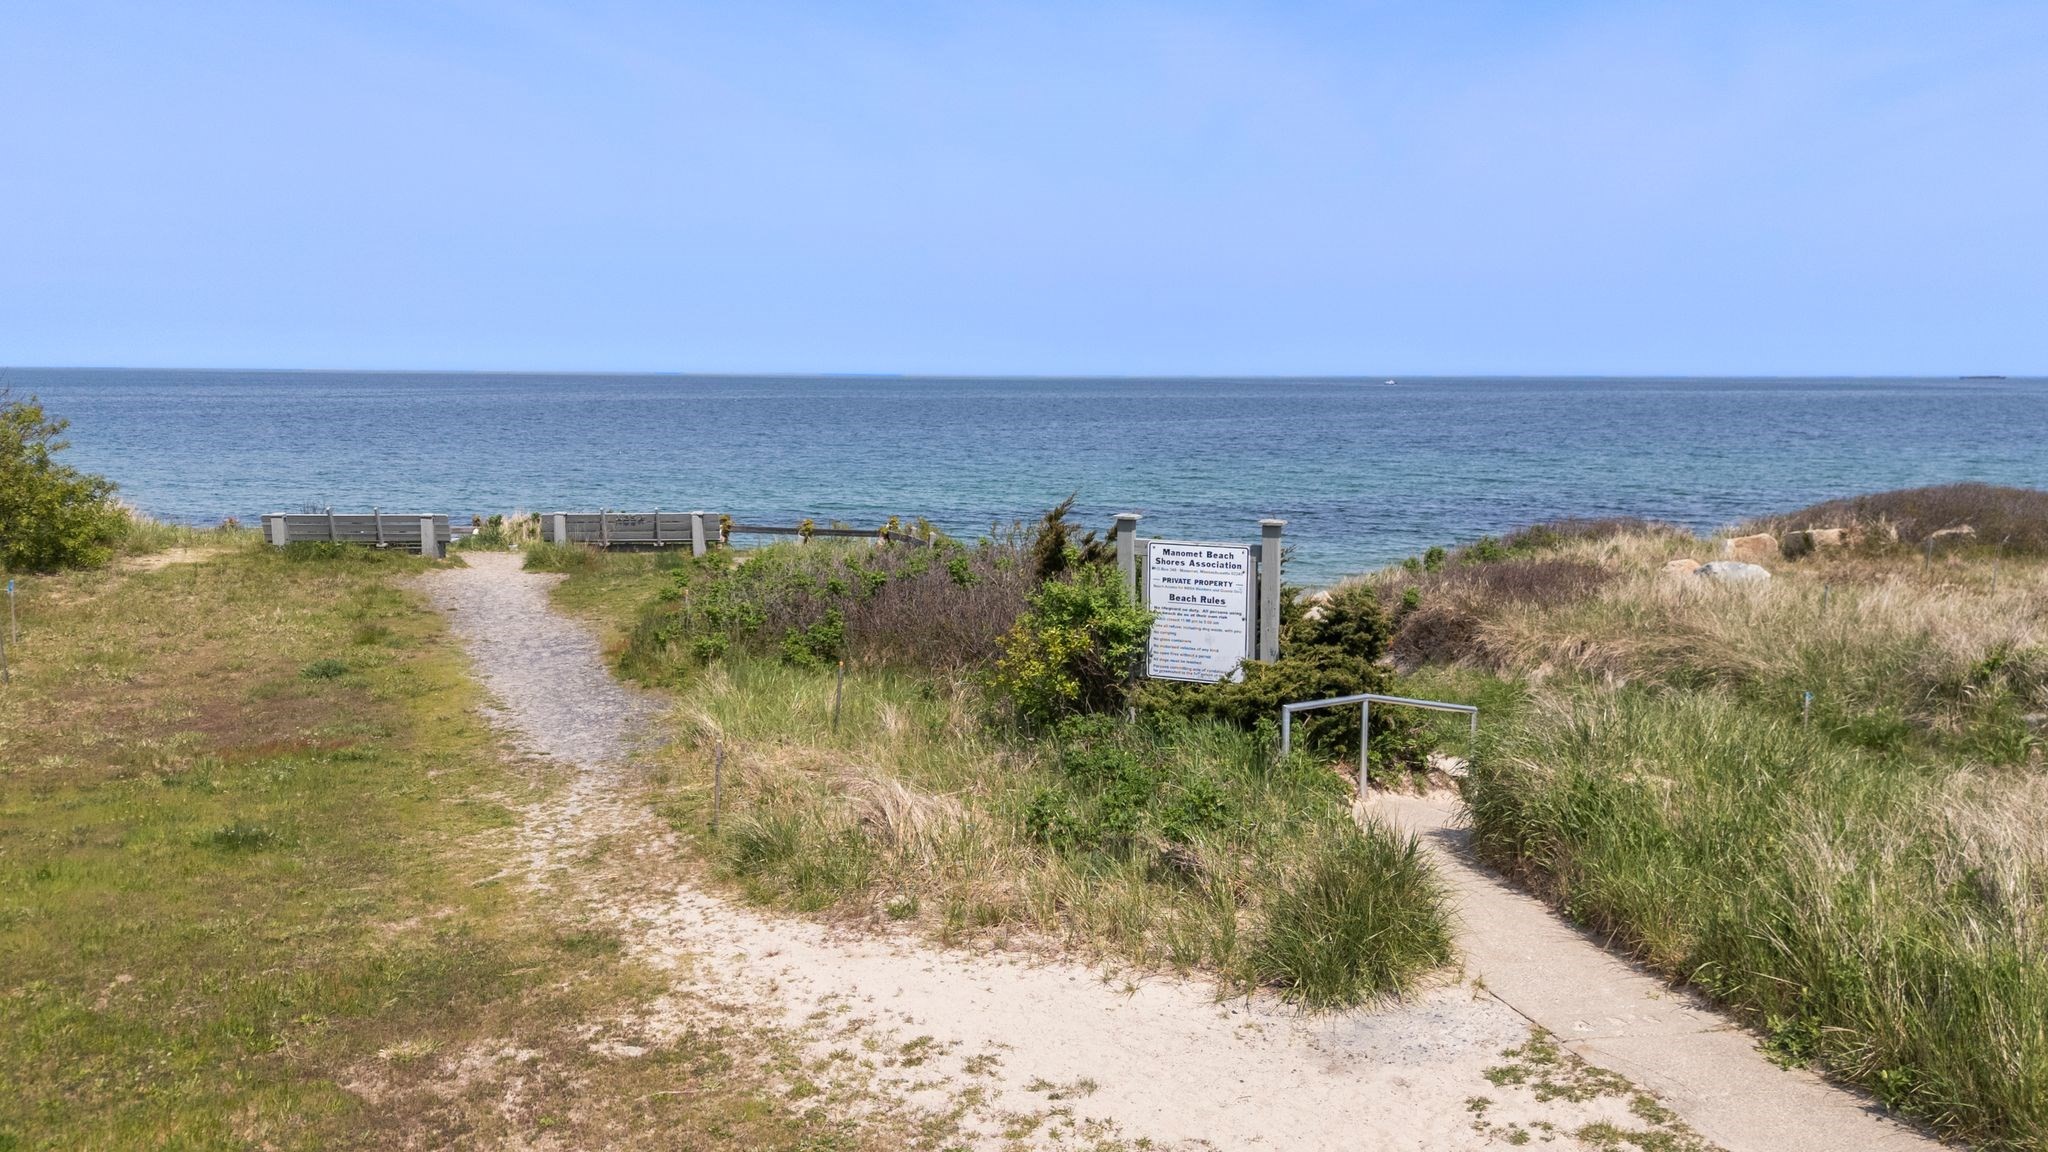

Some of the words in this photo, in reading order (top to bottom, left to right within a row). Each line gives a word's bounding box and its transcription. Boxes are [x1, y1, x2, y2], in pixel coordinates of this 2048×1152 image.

[1163, 549, 1202, 558] Manomet
[1156, 558, 1185, 566] Shores
[1189, 560, 1242, 569] Association
[1169, 594, 1196, 602] Beach
[1200, 596, 1226, 604] Rules
